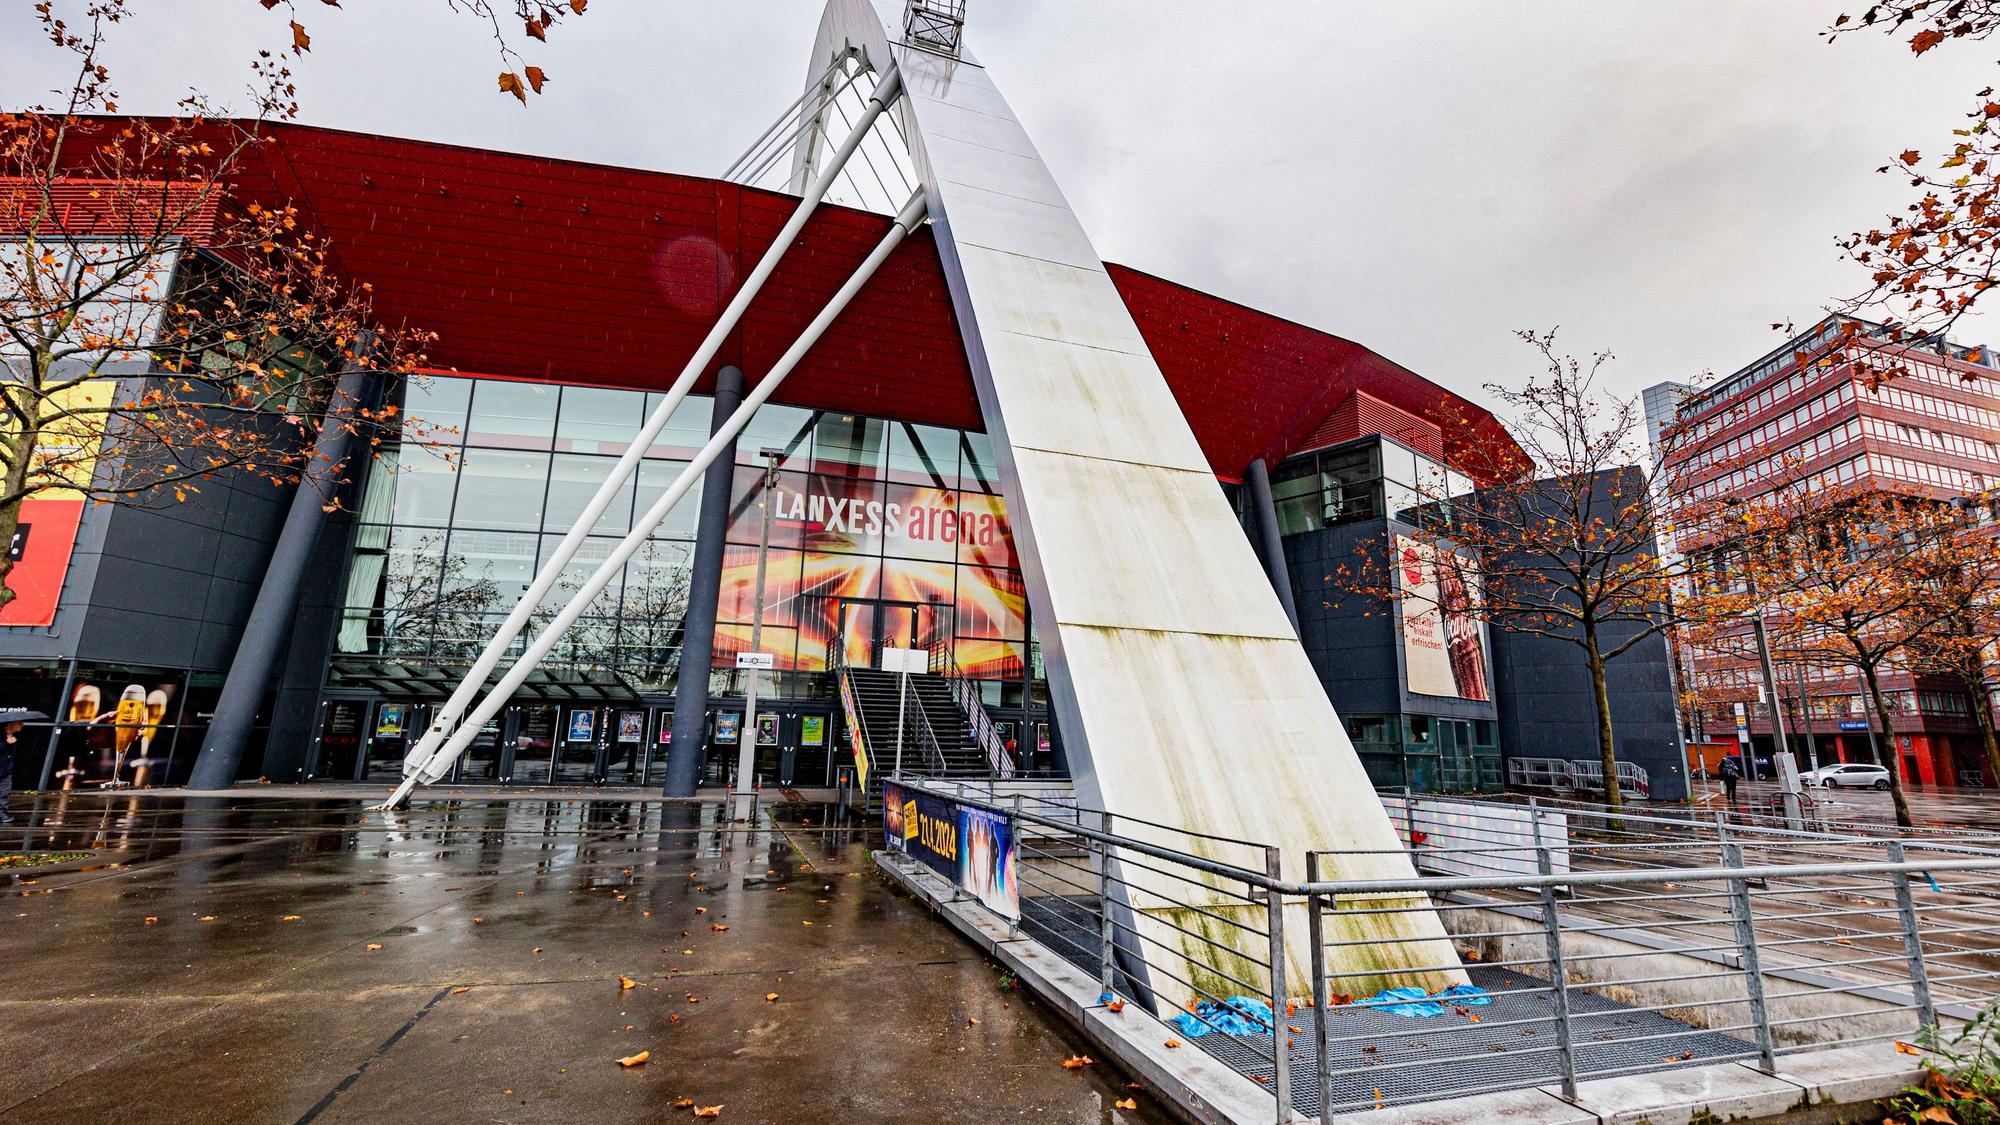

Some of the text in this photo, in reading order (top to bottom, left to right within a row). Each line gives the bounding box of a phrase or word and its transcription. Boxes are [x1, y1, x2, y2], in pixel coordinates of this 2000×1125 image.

[775, 490, 995, 547] LANXESS arena
[1411, 637, 1444, 651] erfrischen!
[1413, 627, 1433, 638] eiskalt
[919, 813, 957, 862] 21.4.2024
